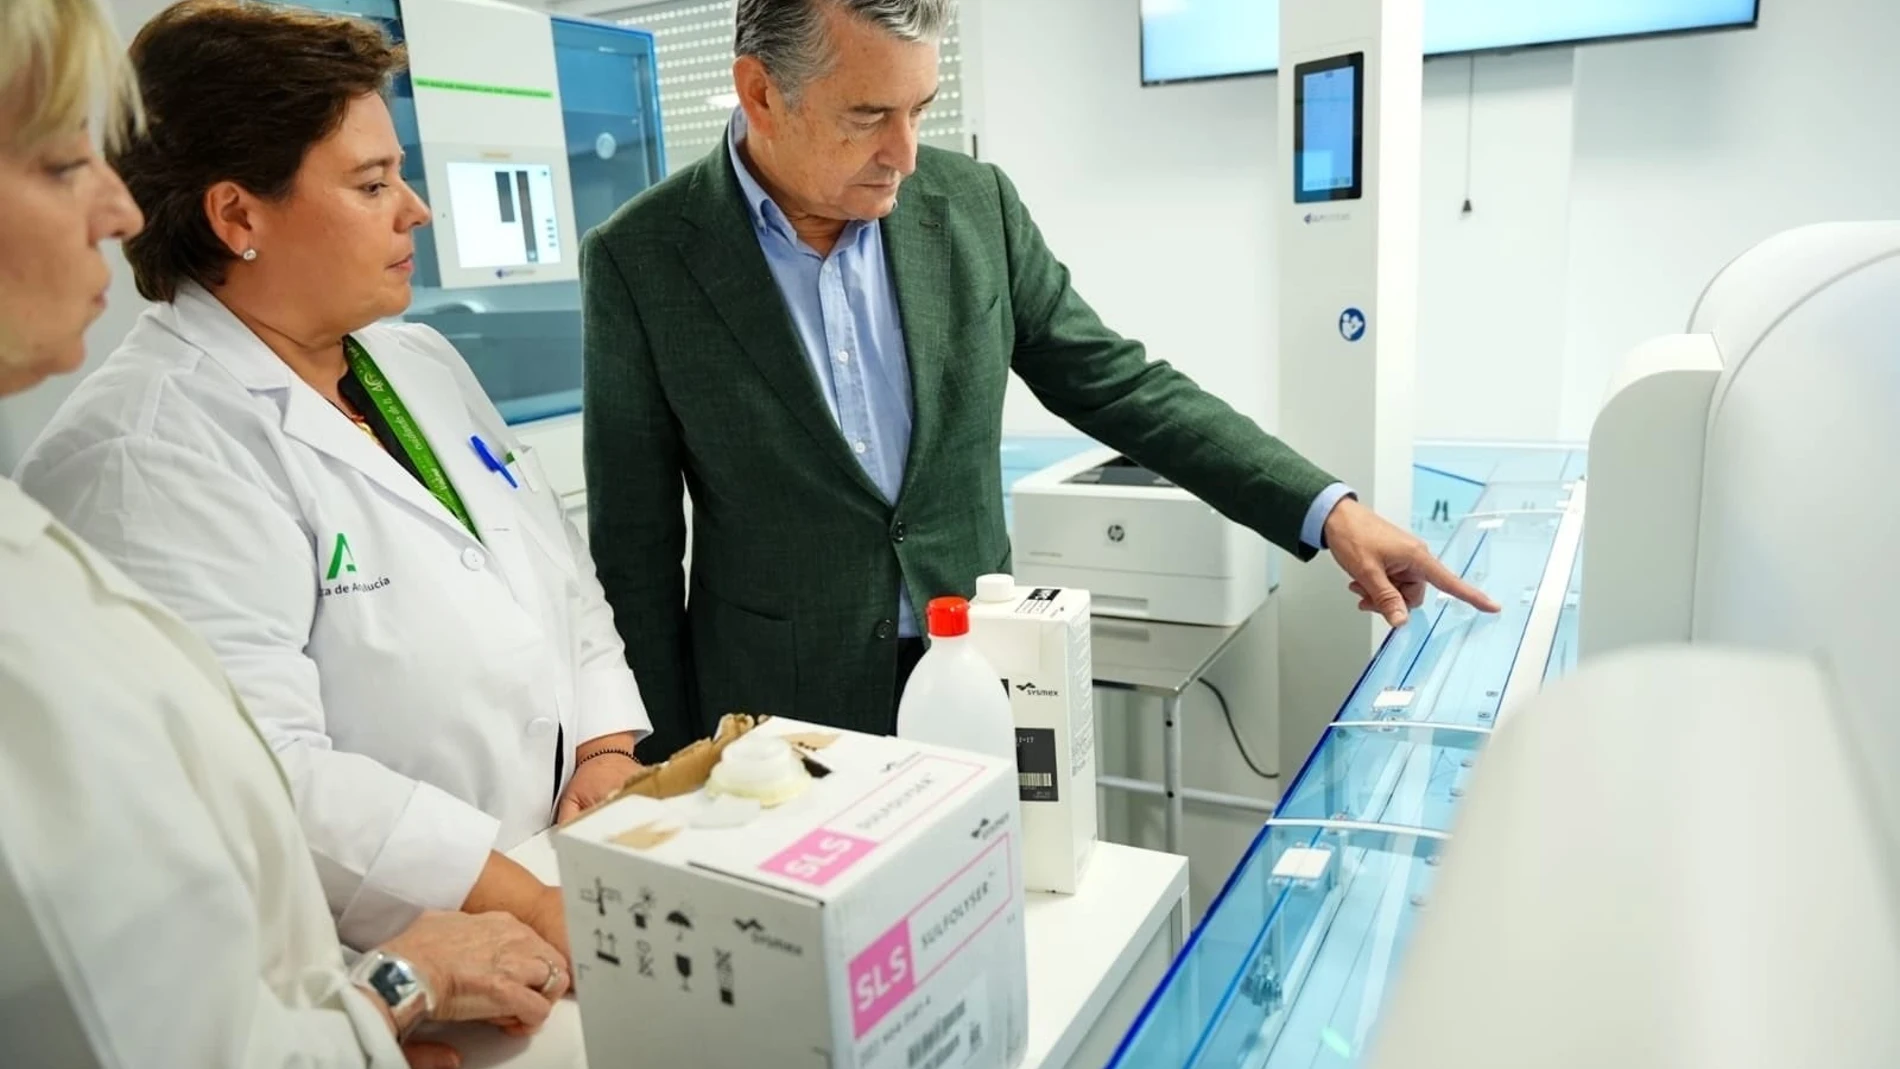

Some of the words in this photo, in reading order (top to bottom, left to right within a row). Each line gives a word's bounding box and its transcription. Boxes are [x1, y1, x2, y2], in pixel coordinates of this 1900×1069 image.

[334, 583, 350, 595] de
[784, 837, 853, 877] SLS
[855, 944, 908, 1013] SLS
